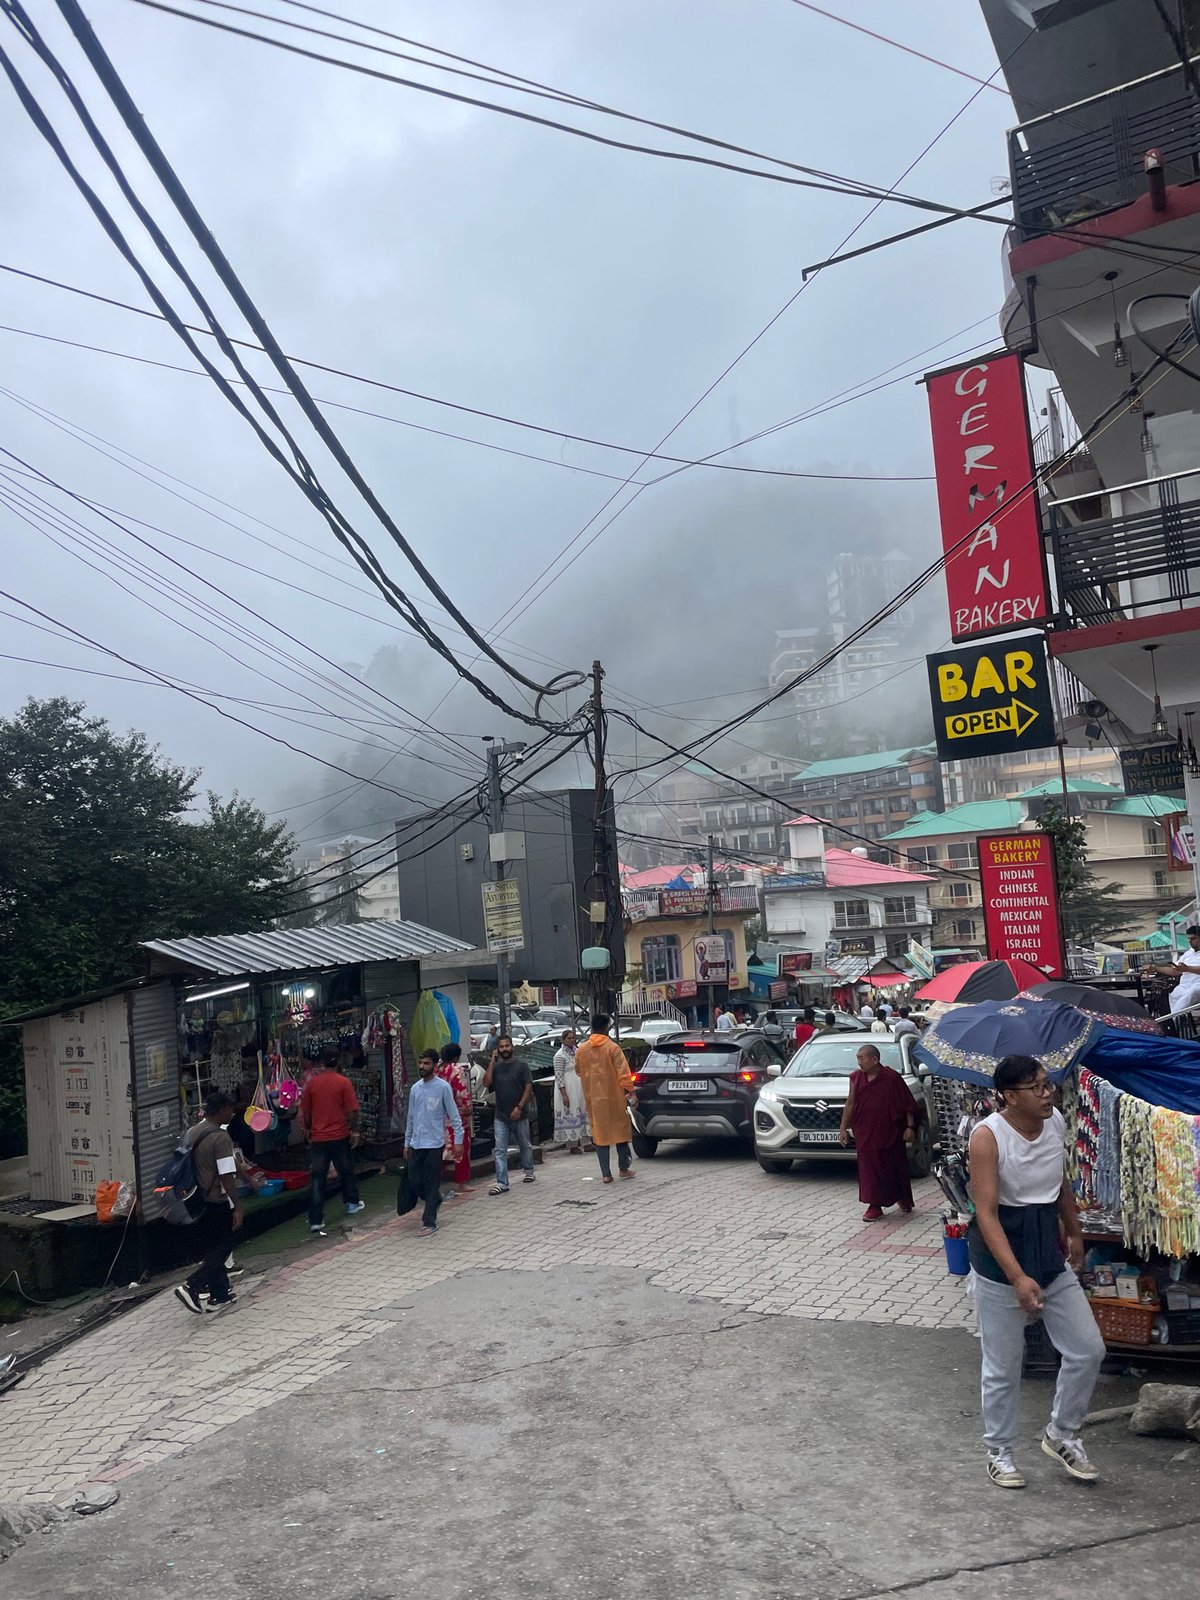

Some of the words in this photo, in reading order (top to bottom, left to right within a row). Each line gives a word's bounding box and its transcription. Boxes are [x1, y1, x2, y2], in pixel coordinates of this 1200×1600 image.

[954, 364, 1010, 595] GERMAN
[954, 594, 1041, 634] BAKERY
[937, 650, 1037, 703] BAR
[951, 708, 1012, 736] OPEN
[989, 838, 1041, 852] GERMAN
[993, 851, 1039, 863] BAKERY
[999, 869, 1035, 880] INDIAN
[998, 883, 1038, 894] CHINESE
[990, 896, 1050, 908] CONTINENTAL
[1000, 910, 1043, 922] MEXICAN
[1004, 925, 1040, 935] ITALIAN
[1006, 938, 1041, 949] ISRAELI
[1011, 952, 1038, 962] FOOD
